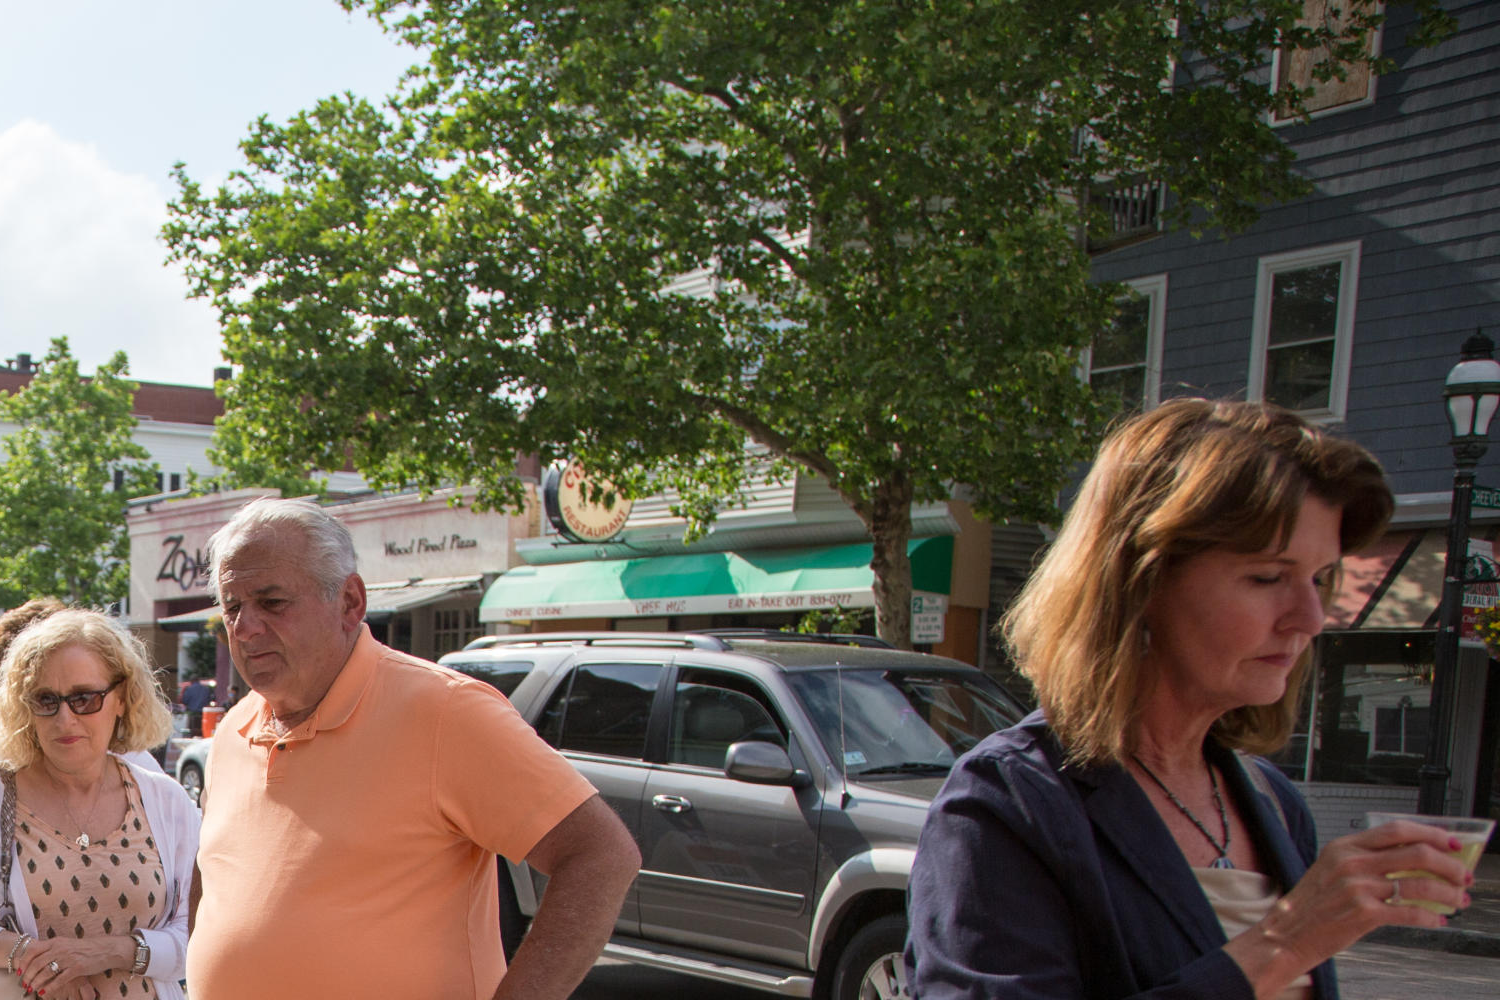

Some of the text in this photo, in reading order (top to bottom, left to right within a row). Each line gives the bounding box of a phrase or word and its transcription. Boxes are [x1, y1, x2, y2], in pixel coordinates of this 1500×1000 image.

[563, 505, 626, 537] RESTAURANT
[728, 598, 743, 609] EAT
[786, 596, 804, 607] OUT
